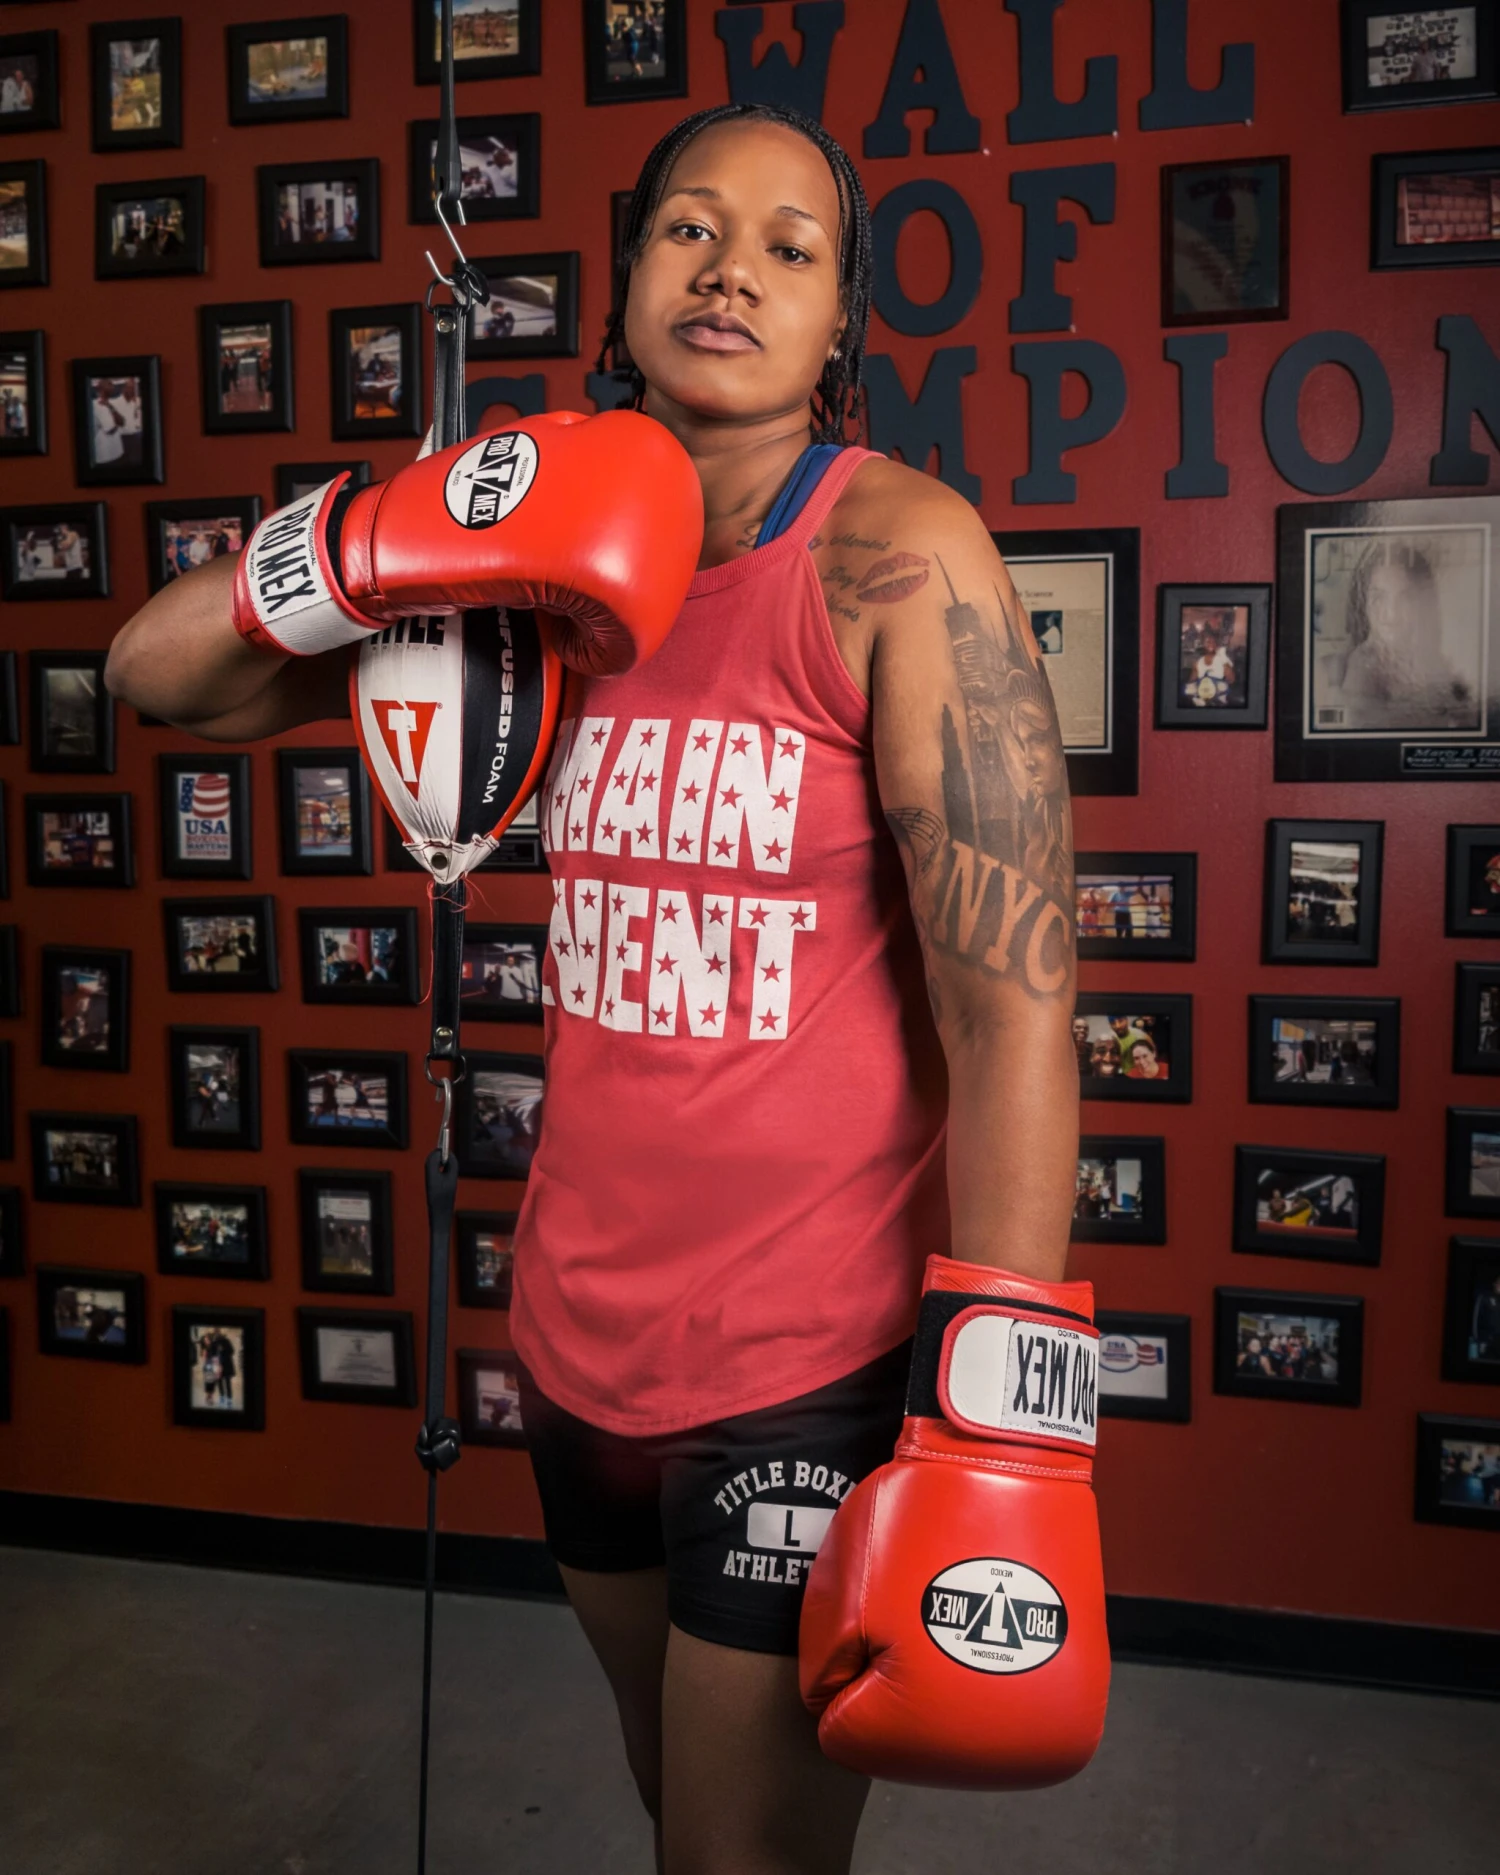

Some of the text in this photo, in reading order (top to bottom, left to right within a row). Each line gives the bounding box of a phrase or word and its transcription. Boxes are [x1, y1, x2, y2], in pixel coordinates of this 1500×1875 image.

[715, 0, 1255, 158] WALL
[871, 162, 1116, 337] OF
[487, 436, 515, 456] PRO
[471, 493, 498, 523] MEX
[257, 502, 317, 613] PRO MEX
[482, 606, 514, 803] NFUSED FOAM
[185, 820, 228, 835] USA
[933, 839, 1070, 993] NYC
[542, 877, 817, 1040] VENT
[1057, 1329, 1080, 1340] MEXICO
[1013, 1333, 1096, 1428] PRO MEX
[1038, 1420, 1082, 1435] PROFESSIONAL
[713, 1461, 786, 1516] TITLE
[784, 1509, 801, 1547] L
[990, 1567, 1014, 1578] MEXICO
[929, 1592, 969, 1626] MEX
[1025, 1607, 1058, 1639] PRO
[970, 1648, 1014, 1663] PROFESSIONAL
